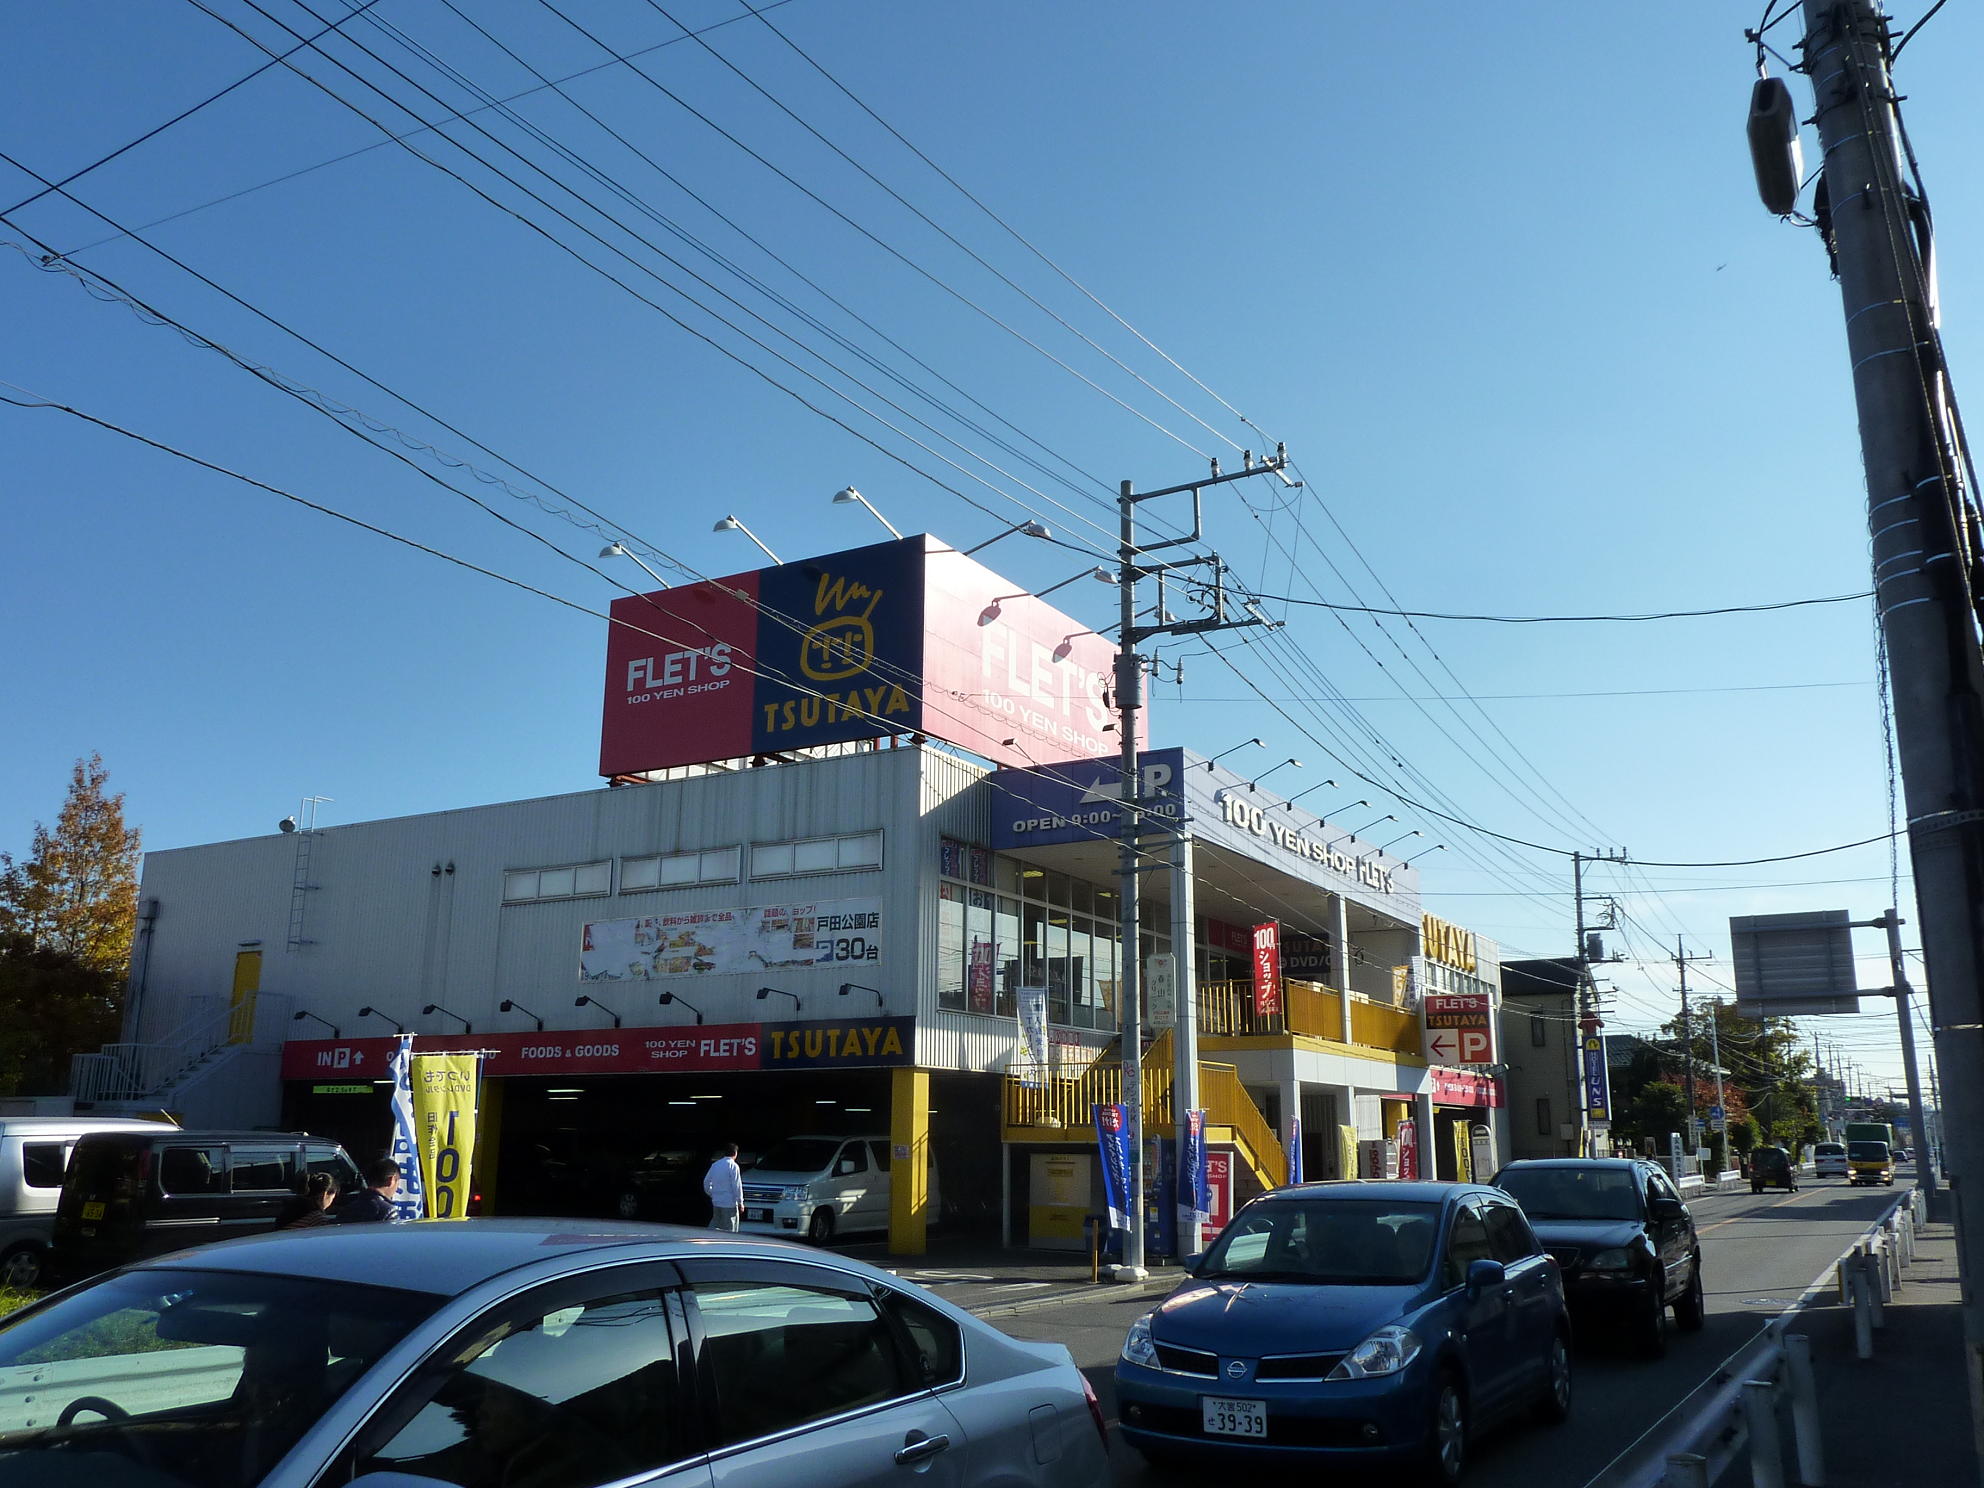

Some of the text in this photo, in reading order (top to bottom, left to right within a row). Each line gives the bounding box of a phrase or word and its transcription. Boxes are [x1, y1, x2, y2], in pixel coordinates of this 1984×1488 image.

[627, 643, 732, 692] FLET'S
[982, 624, 1109, 732] FLET'S
[627, 680, 730, 704] 100 YEN SHOP
[764, 683, 910, 733] TSUTAYA
[982, 688, 1109, 754] 100 YEN SHOP
[1143, 763, 1172, 798] P
[1012, 815, 1066, 833] OPEN
[1219, 793, 1267, 837] 100
[1269, 821, 1311, 858] YEN
[1309, 841, 1355, 876] SHOP
[816, 912, 880, 933] 戸田公園店
[1435, 998, 1478, 1009] FLET'S
[1428, 1014, 1488, 1027] TSUTAYA
[521, 1045, 562, 1058] FOODS
[575, 1043, 620, 1058] GOODS
[644, 1039, 696, 1048] 100 YEN
[650, 1050, 688, 1059] SHOP
[700, 1037, 757, 1057] FLET'S
[771, 1026, 904, 1060] TSUTAYA
[1463, 1032, 1488, 1061] P
[1217, 1412, 1264, 1434] 39-39
